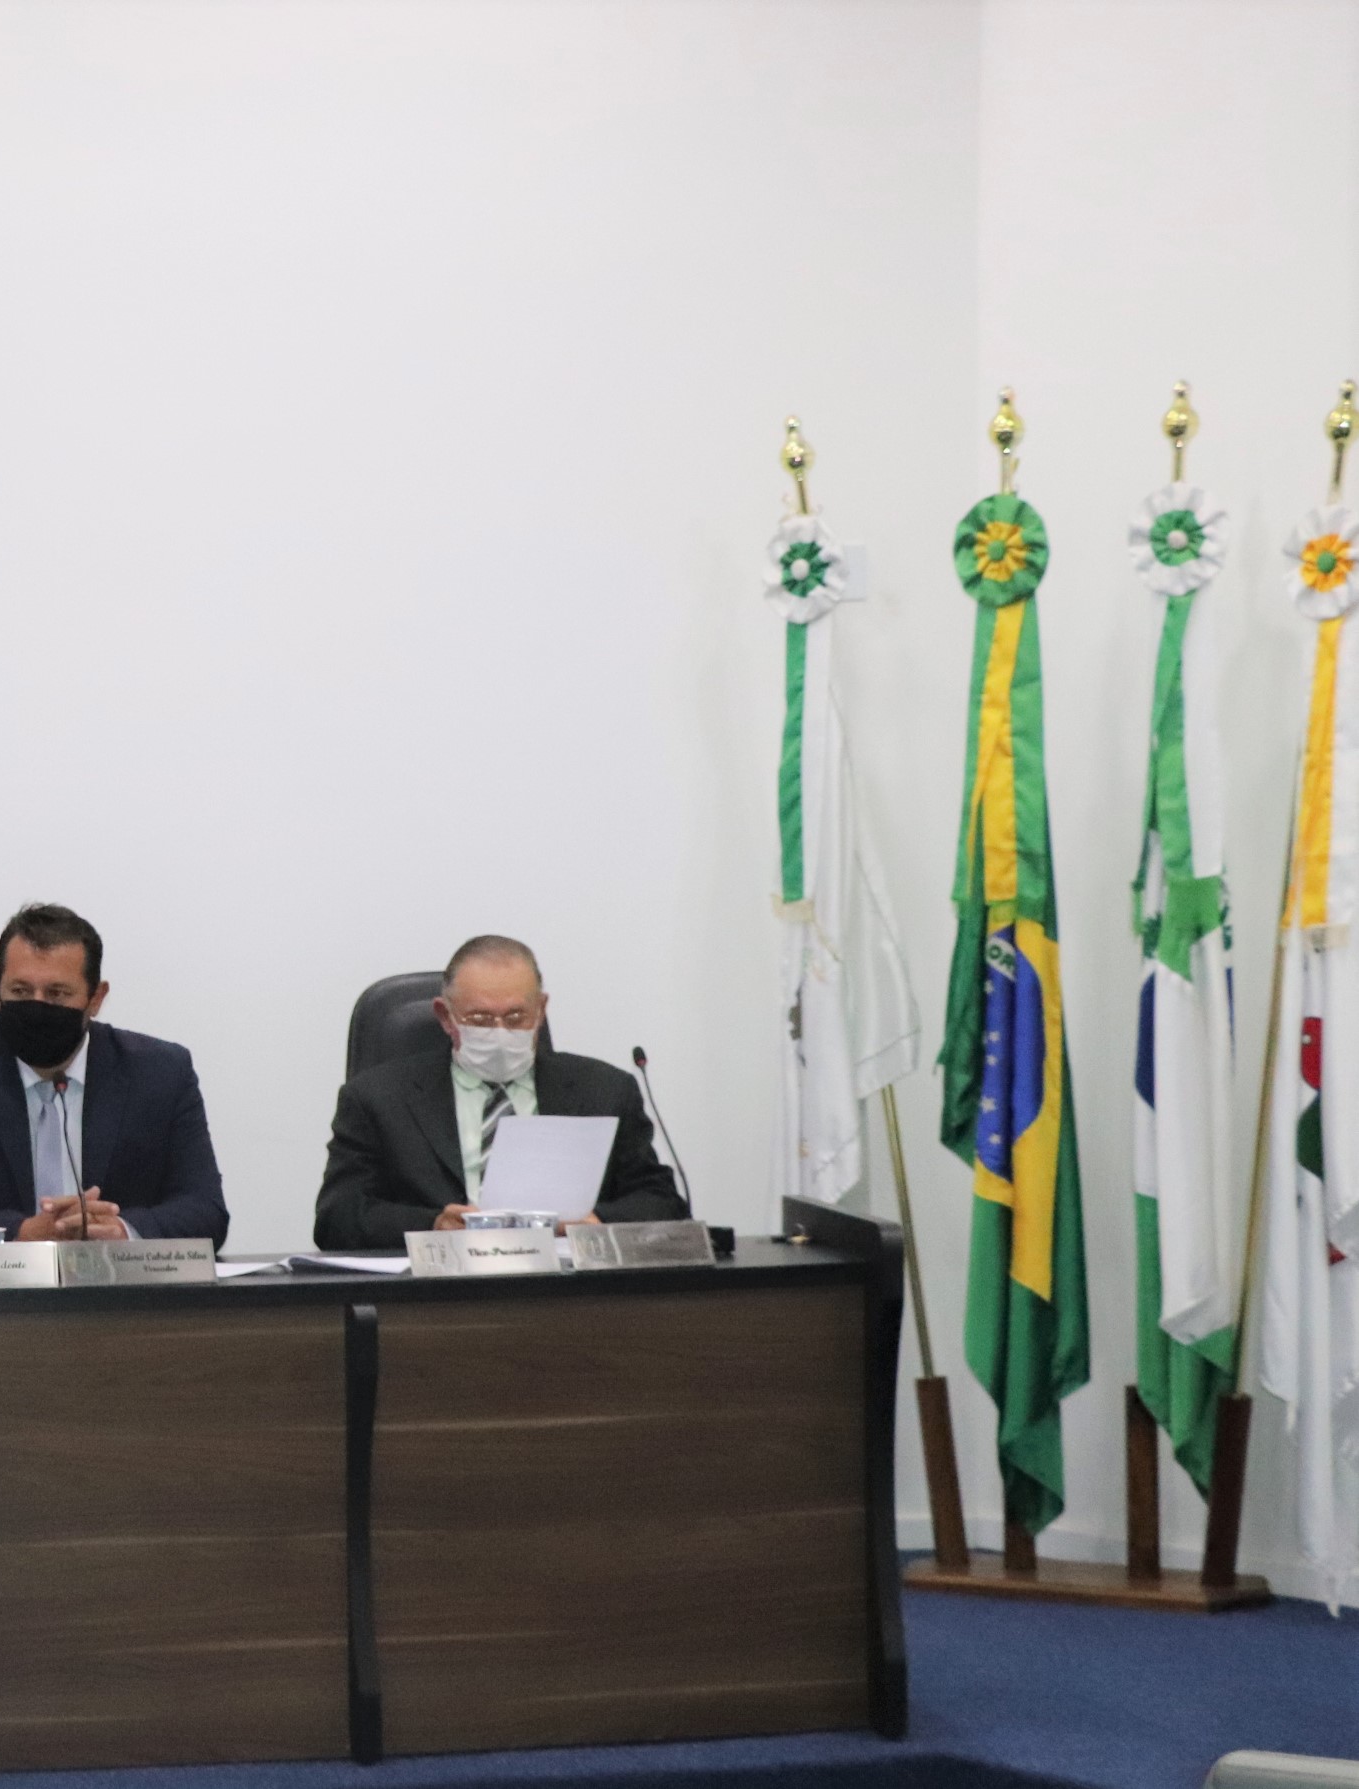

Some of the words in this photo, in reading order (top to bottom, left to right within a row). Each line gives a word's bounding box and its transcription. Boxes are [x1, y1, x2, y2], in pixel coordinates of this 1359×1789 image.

[146, 1251, 172, 1261] Cabral
[174, 1251, 185, 1260] da
[187, 1250, 208, 1260] Silva
